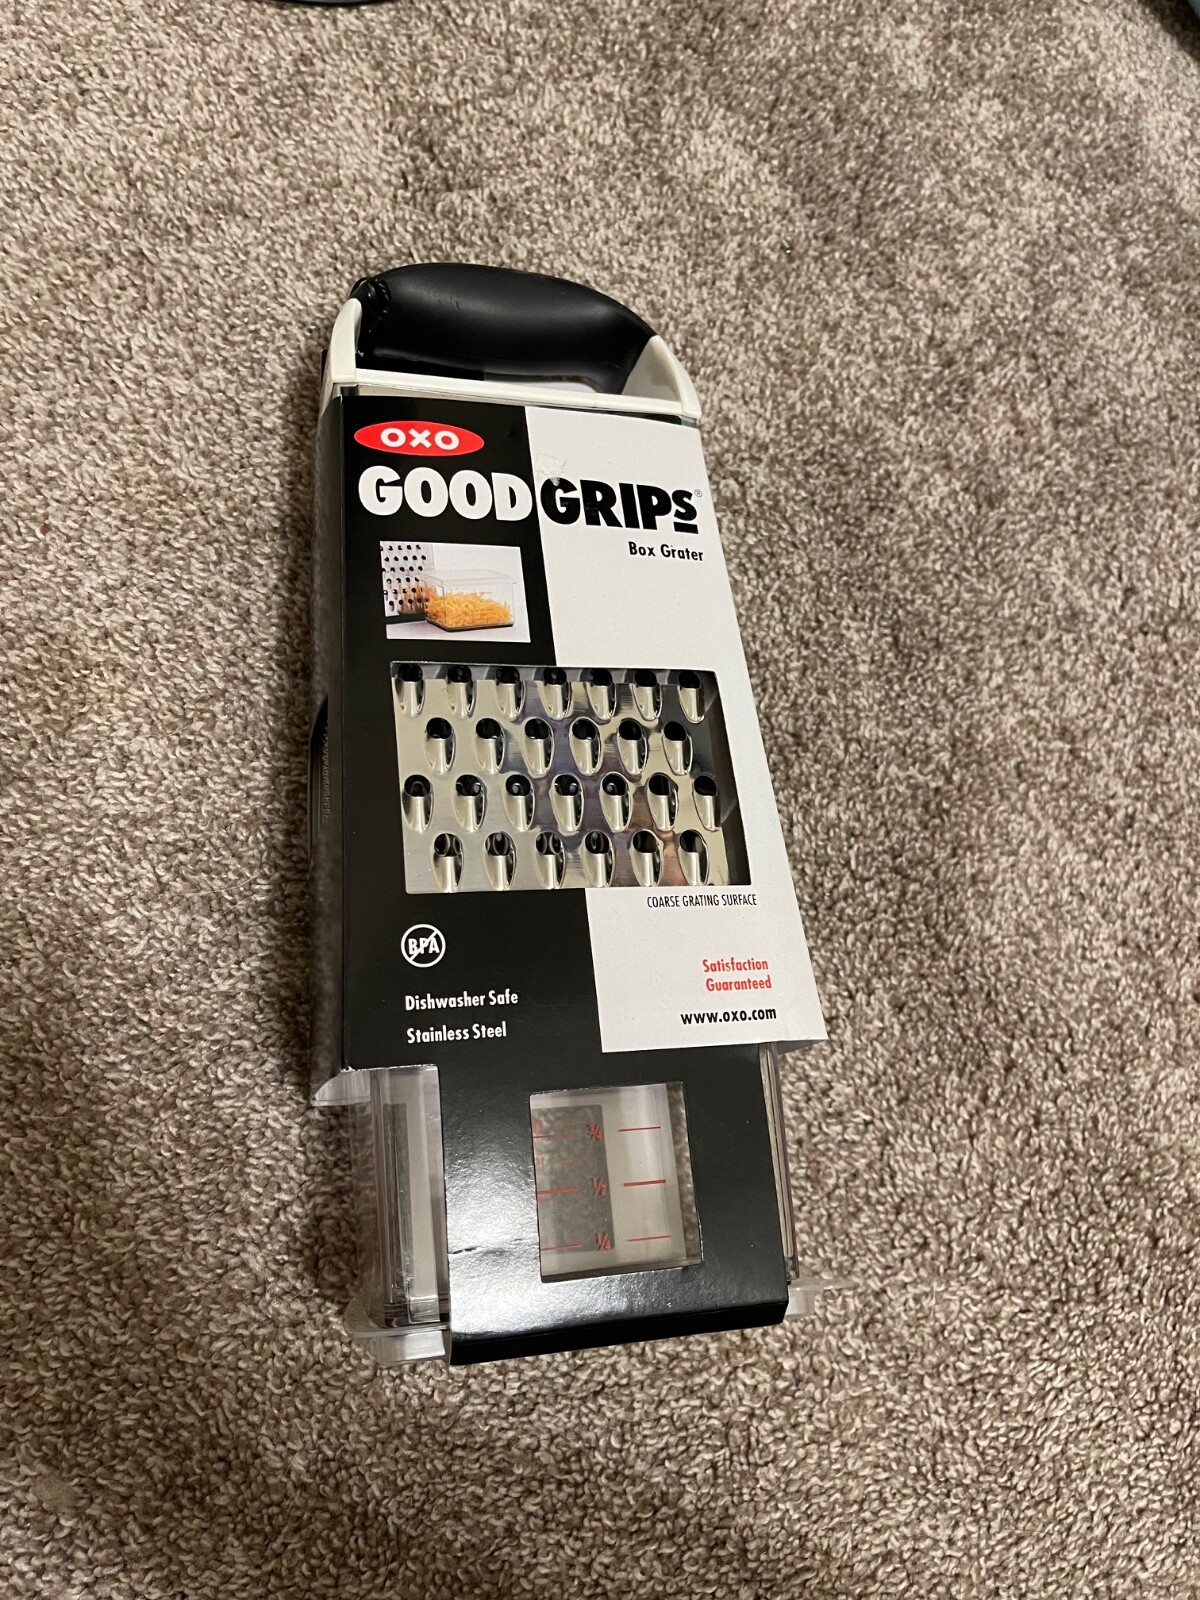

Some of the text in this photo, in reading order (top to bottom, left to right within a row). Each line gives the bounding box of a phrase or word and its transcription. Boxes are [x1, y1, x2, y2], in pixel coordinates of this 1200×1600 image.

[380, 427, 460, 450] OXO
[358, 465, 533, 522] GOOD
[628, 541, 703, 561] Box Grater
[647, 894, 757, 908] COARSE GRATING SURFACE
[408, 936, 440, 956] BPA
[702, 957, 769, 973] Satisfaction
[706, 975, 772, 991] Guaranteed
[405, 990, 519, 1011] Dishwasher Safe
[680, 1008, 777, 1025] www.oxo.com
[407, 1021, 507, 1044] Stainless Steel
